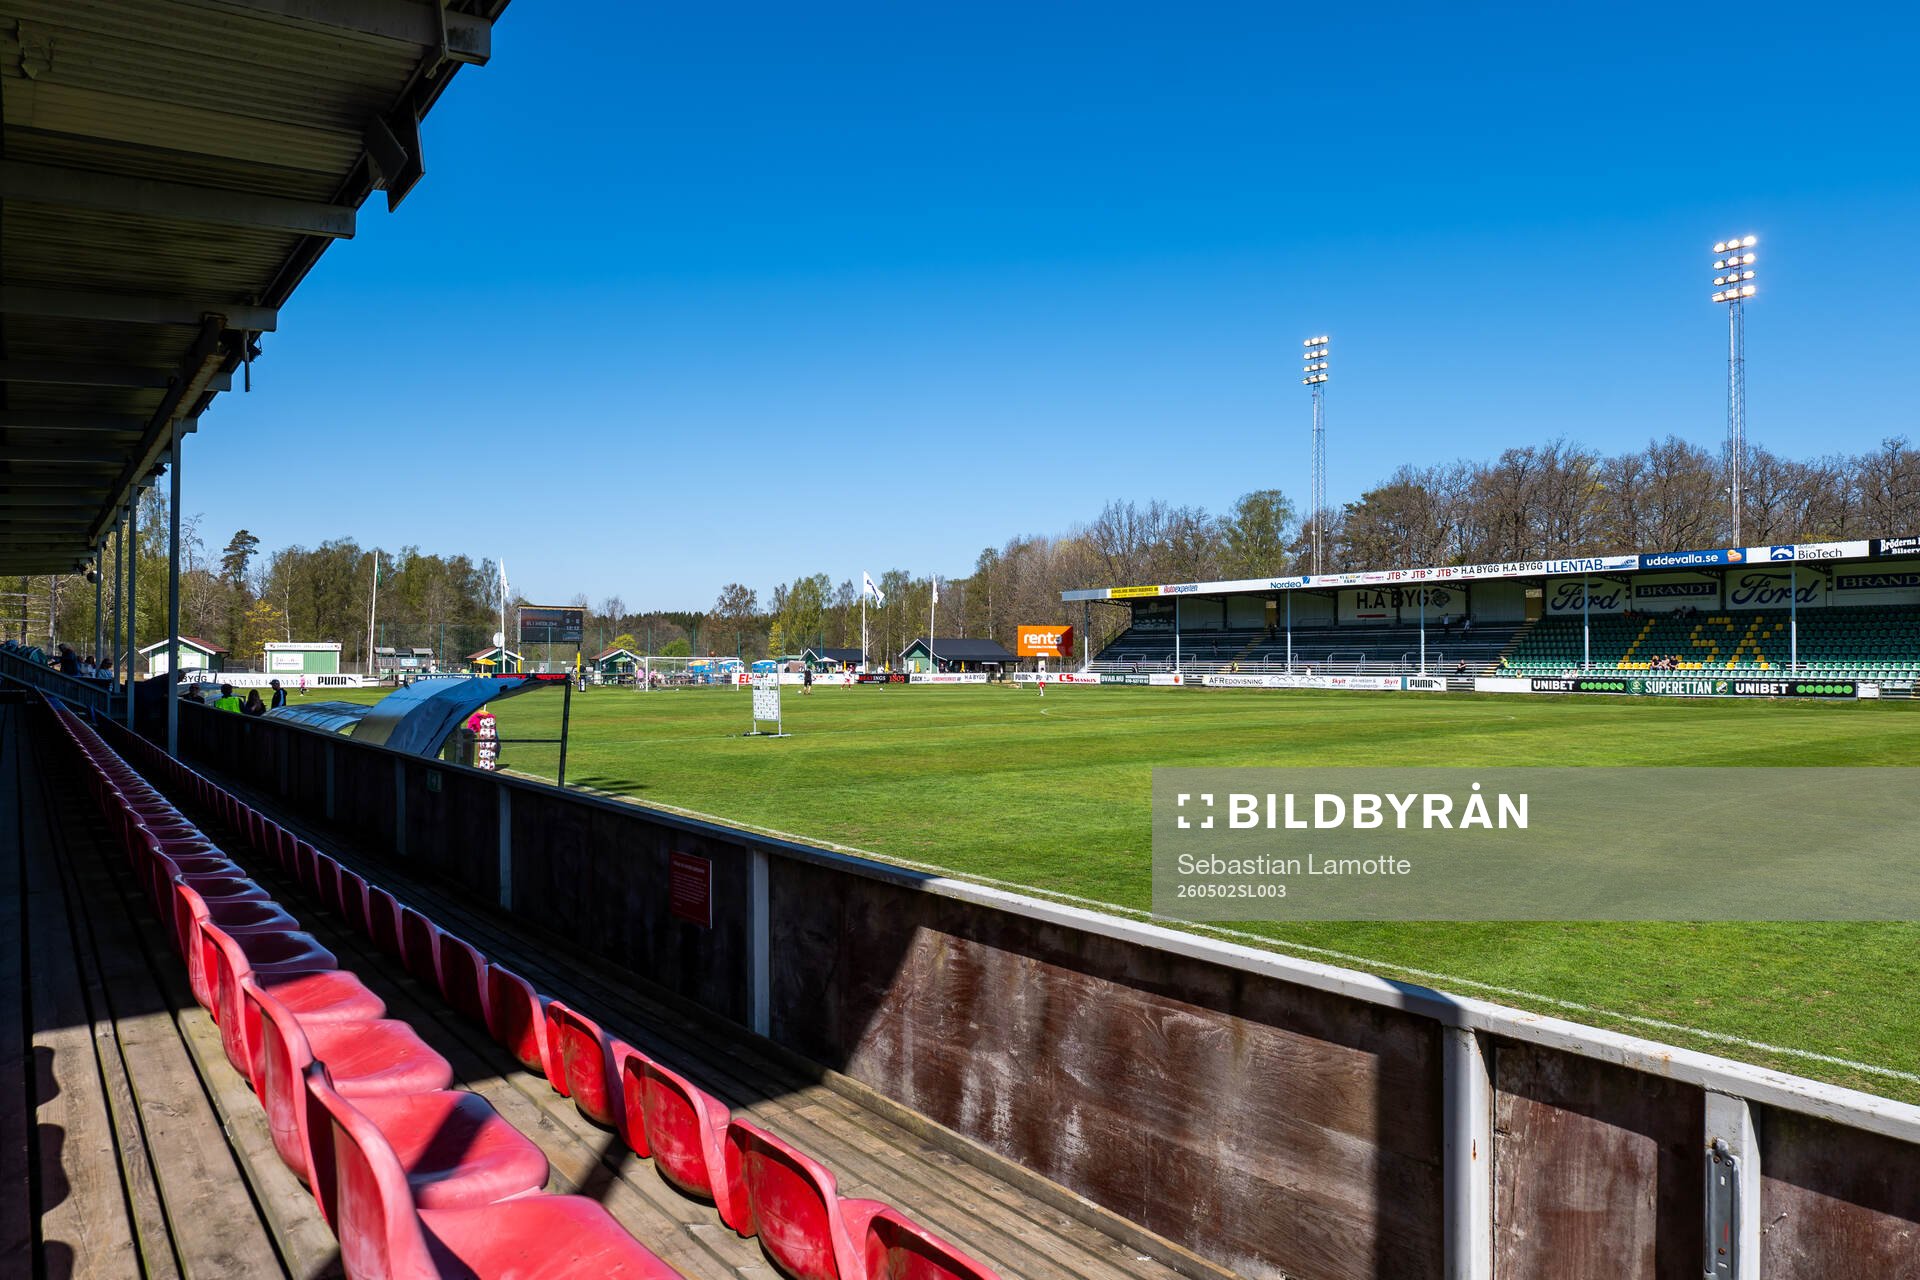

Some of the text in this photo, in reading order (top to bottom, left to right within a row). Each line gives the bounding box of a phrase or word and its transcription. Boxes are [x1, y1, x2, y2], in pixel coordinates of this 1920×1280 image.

[1880, 538, 1916, 552] Bröderna
[1798, 548, 1842, 559] BioTech
[1891, 547, 1920, 555] Bilserv
[1646, 554, 1718, 566] uddevalla.se
[1461, 564, 1499, 575] H.A BYGG
[1502, 561, 1543, 573] H.A BYGG
[1546, 559, 1602, 573] LLENTAB
[1386, 571, 1401, 581] JTB
[1410, 570, 1426, 580] JTB
[1436, 569, 1451, 578] JTB
[1270, 580, 1302, 590] Nordea
[1842, 575, 1920, 587] BRAND
[1640, 584, 1713, 596] BRANDT
[1731, 573, 1820, 605] Ford
[1356, 591, 1386, 609] H.A
[1551, 583, 1621, 611] Ford
[1023, 631, 1063, 645] renta
[317, 675, 348, 686] PUMA
[1059, 674, 1073, 682] CS
[1409, 679, 1434, 689] PUMA
[1533, 680, 1575, 690] UNIBET
[1645, 681, 1712, 694] SUPERETTAN
[1735, 683, 1789, 694] UNIBET
